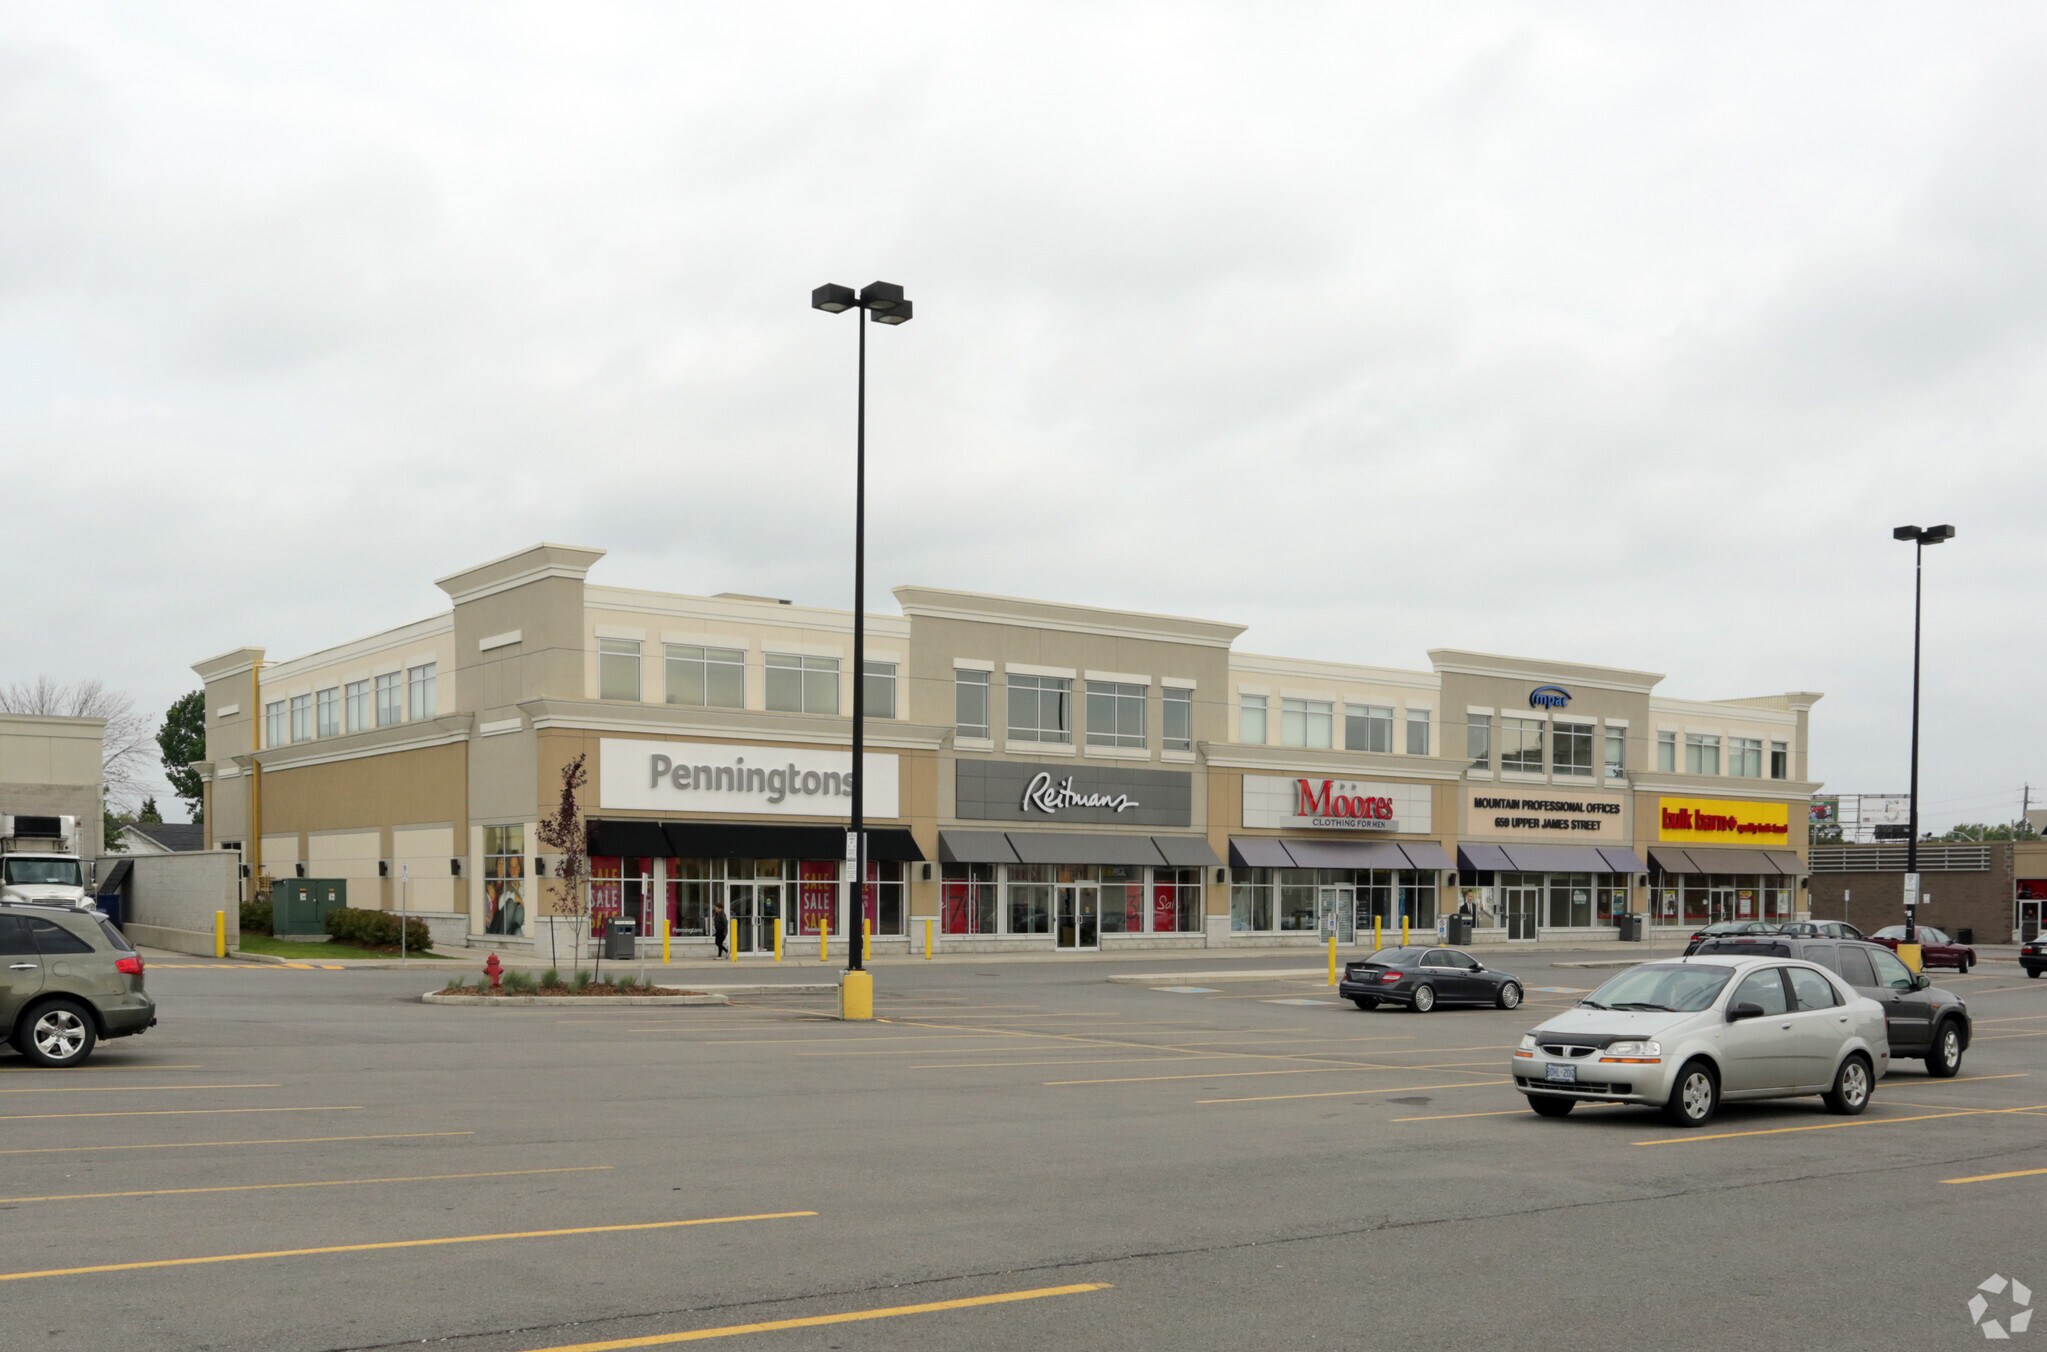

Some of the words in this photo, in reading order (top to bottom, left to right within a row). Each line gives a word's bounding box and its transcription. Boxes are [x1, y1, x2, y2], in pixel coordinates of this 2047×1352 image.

[650, 753, 853, 804] Penningtons
[1023, 771, 1140, 814] Reitmans
[1296, 778, 1394, 821] Moores
[1474, 797, 1520, 810] MOUNTAIN
[1521, 799, 1585, 813] PROFESSIONAL
[1586, 802, 1621, 815] OFFICES
[1312, 818, 1356, 828] CLOTHING
[1357, 820, 1372, 829] FOR
[1372, 821, 1386, 829] MEN
[1494, 817, 1511, 829] 659
[1511, 817, 1540, 829] UPPER
[1541, 819, 1570, 831] JAMES
[1570, 820, 1602, 831] STREET
[1662, 807, 1694, 830] bulk
[1694, 808, 1728, 832] barn
[803, 873, 830, 890] SALE
[803, 893, 830, 910] SALE
